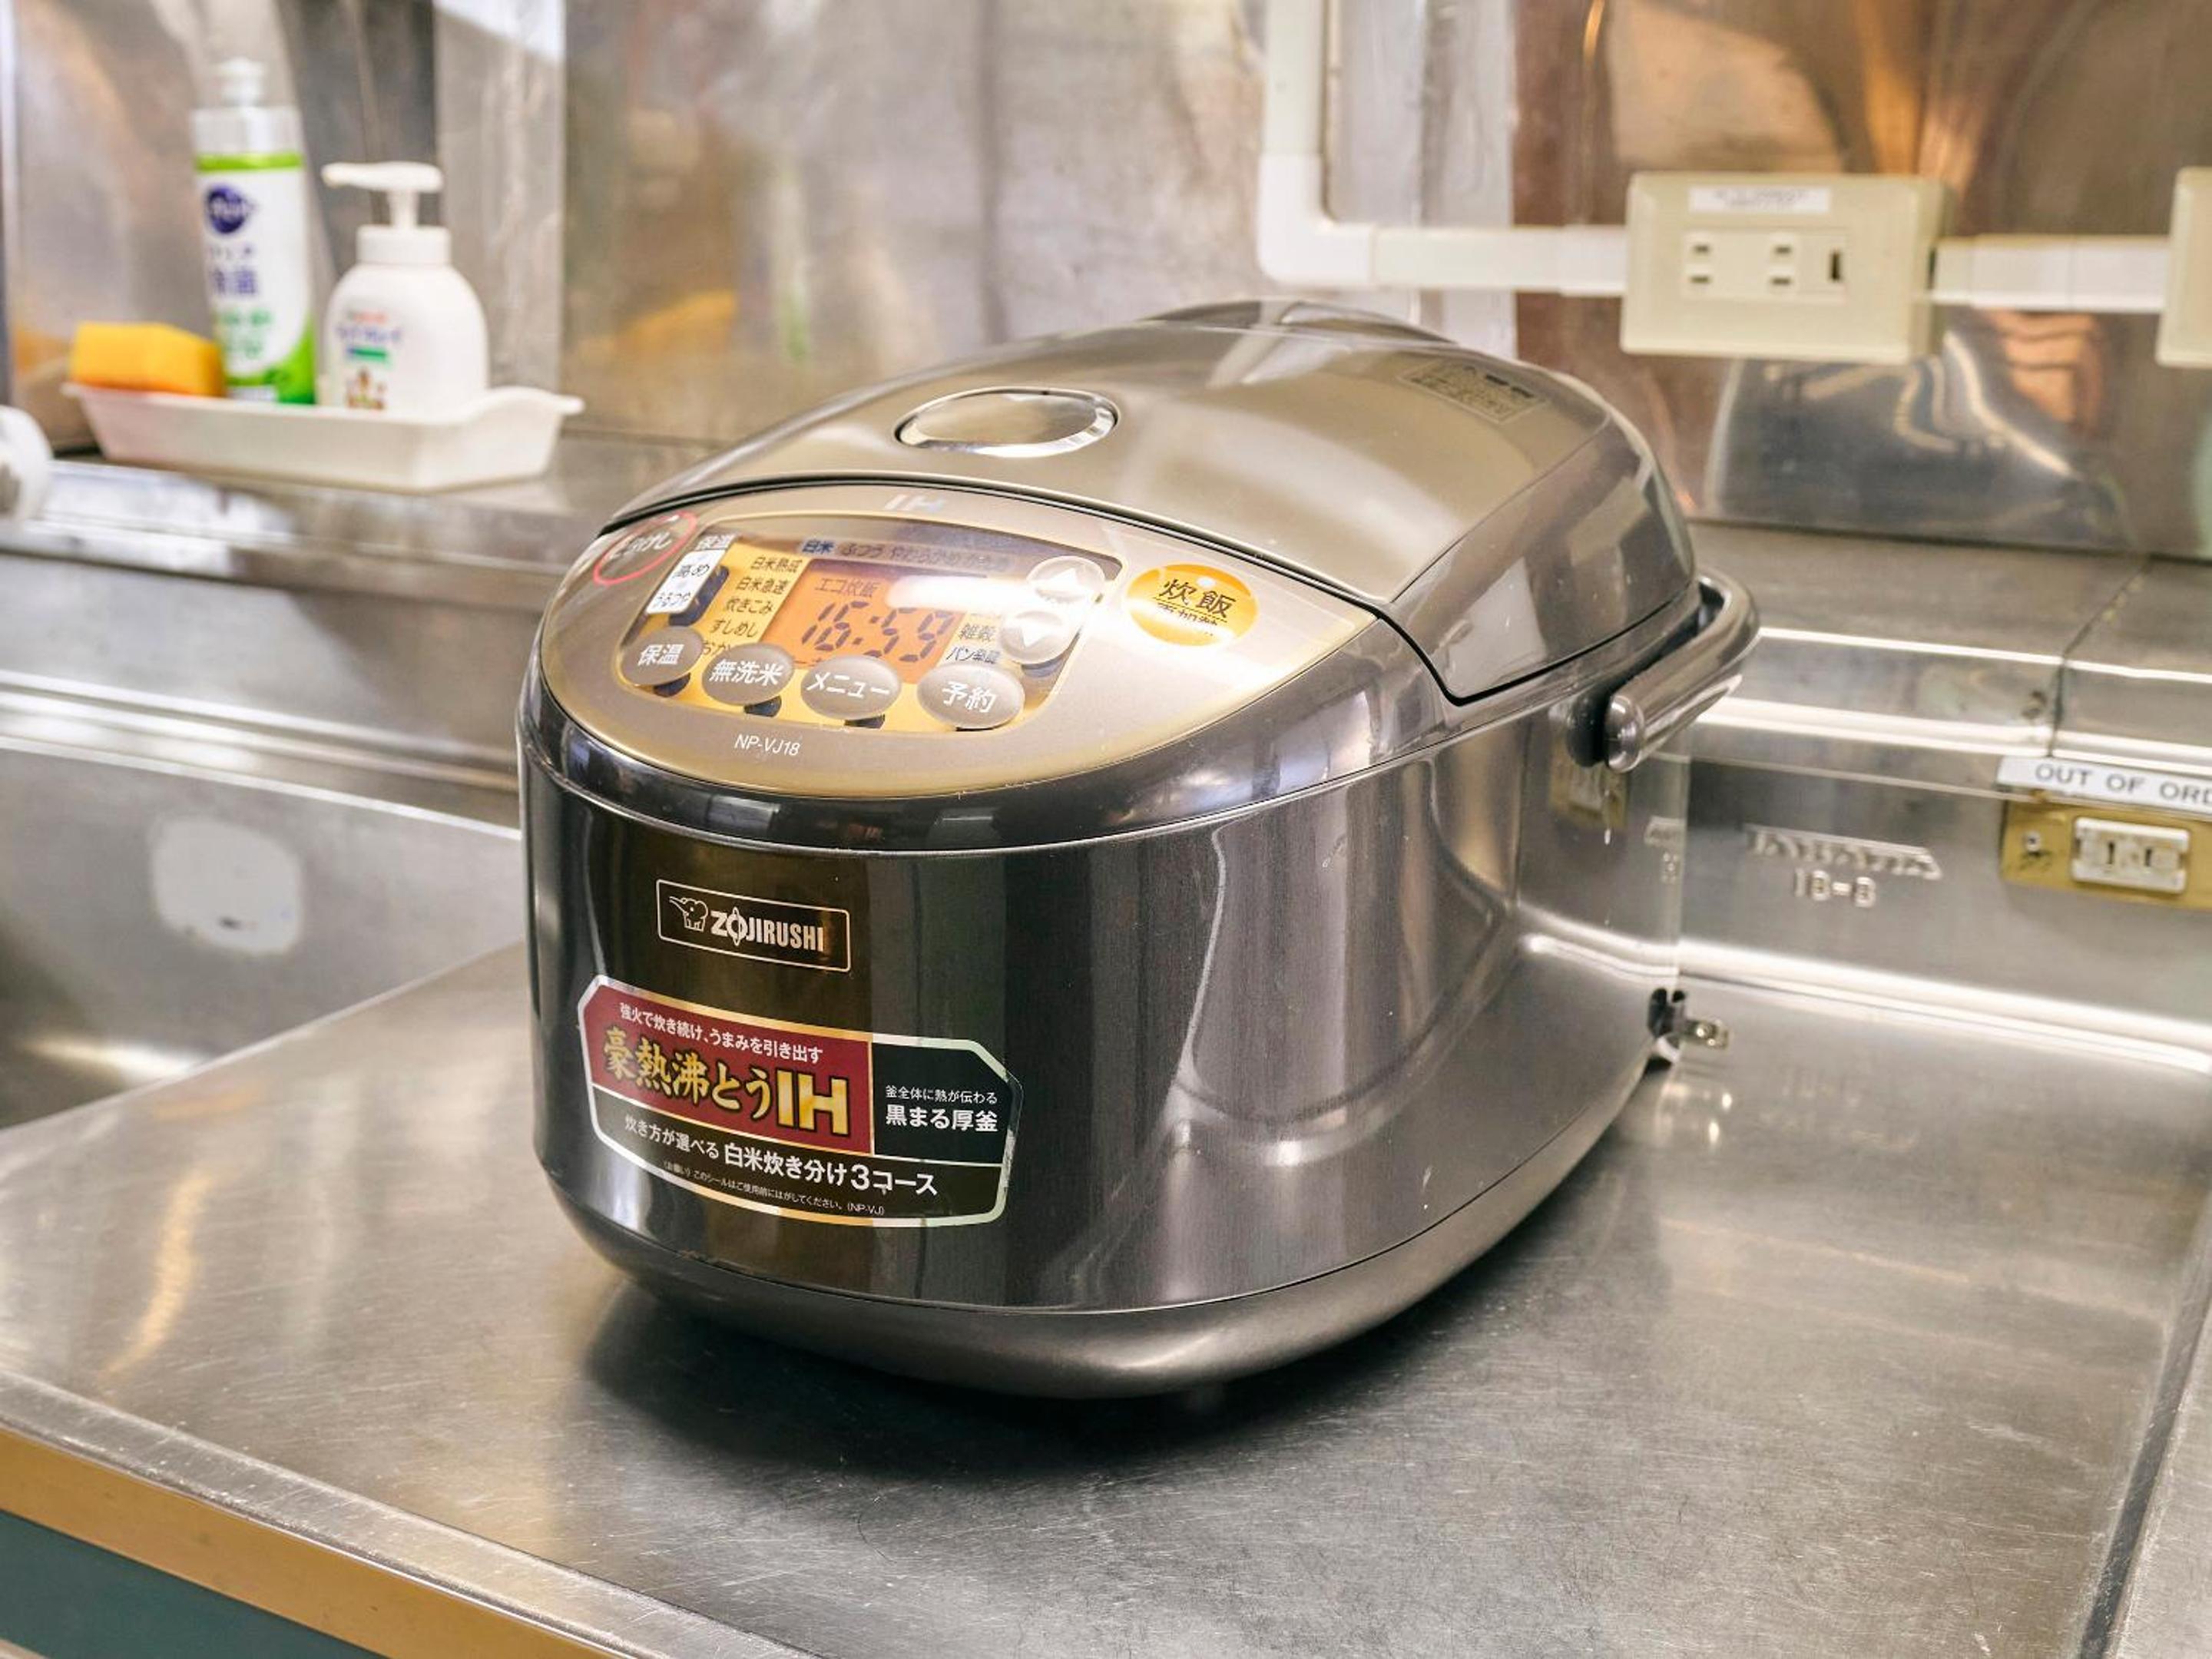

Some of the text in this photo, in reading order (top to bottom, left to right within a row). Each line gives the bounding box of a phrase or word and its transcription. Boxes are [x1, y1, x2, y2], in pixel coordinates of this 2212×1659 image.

[1158, 578, 1237, 618] 炊飯
[709, 618, 759, 637] すしめし
[801, 600, 955, 661] 16:59
[637, 644, 684, 666] 保温
[709, 658, 783, 686] 無洗米
[806, 671, 891, 699] メニュー
[942, 681, 997, 714] 予約
[734, 734, 801, 757] NP-VJ18
[2035, 763, 2091, 786] OUT
[2106, 773, 2145, 793] OF
[710, 905, 824, 952] ZOJIRUSHI
[619, 1002, 823, 1064] 強火で炊き続け、うまみを引き出す
[603, 1025, 849, 1136] 豪熱沸とうIH
[886, 1084, 998, 1104] 釜全体に熱が伝わる
[886, 1104, 998, 1132] 黒まる厚釜
[624, 1114, 719, 1159] 炊き方が選べる
